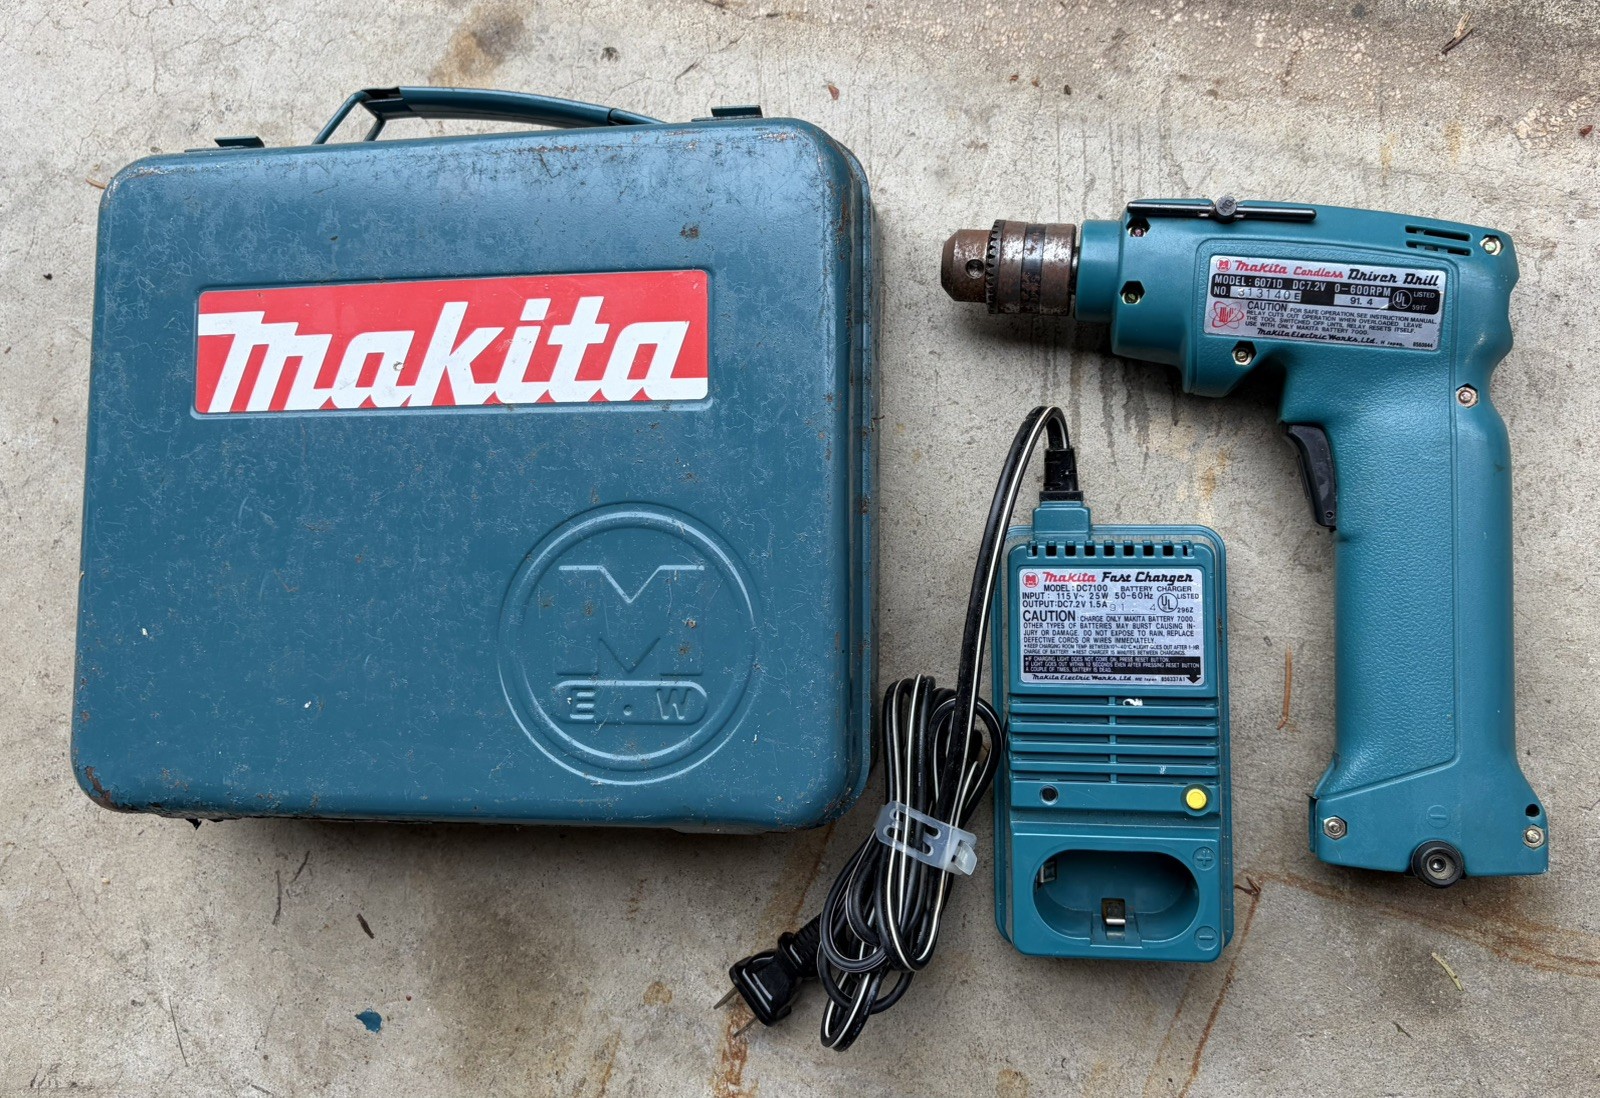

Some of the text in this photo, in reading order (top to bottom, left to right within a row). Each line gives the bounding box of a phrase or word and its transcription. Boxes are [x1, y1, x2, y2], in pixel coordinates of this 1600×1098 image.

[1293, 266, 1344, 279] Cordless
[1348, 268, 1397, 283] Driver
[1403, 273, 1439, 286] Drill
[1213, 287, 1229, 296] NO.
[1254, 278, 1282, 288] 6071D
[1293, 280, 1326, 291] DC7.2V
[1248, 301, 1288, 312] CAUTION
[1370, 314, 1409, 322] INSTRUCTION
[1291, 331, 1326, 340] Electric
[1101, 572, 1131, 582] Fast
[1135, 571, 1194, 586] Charger
[557, 566, 704, 676] M
